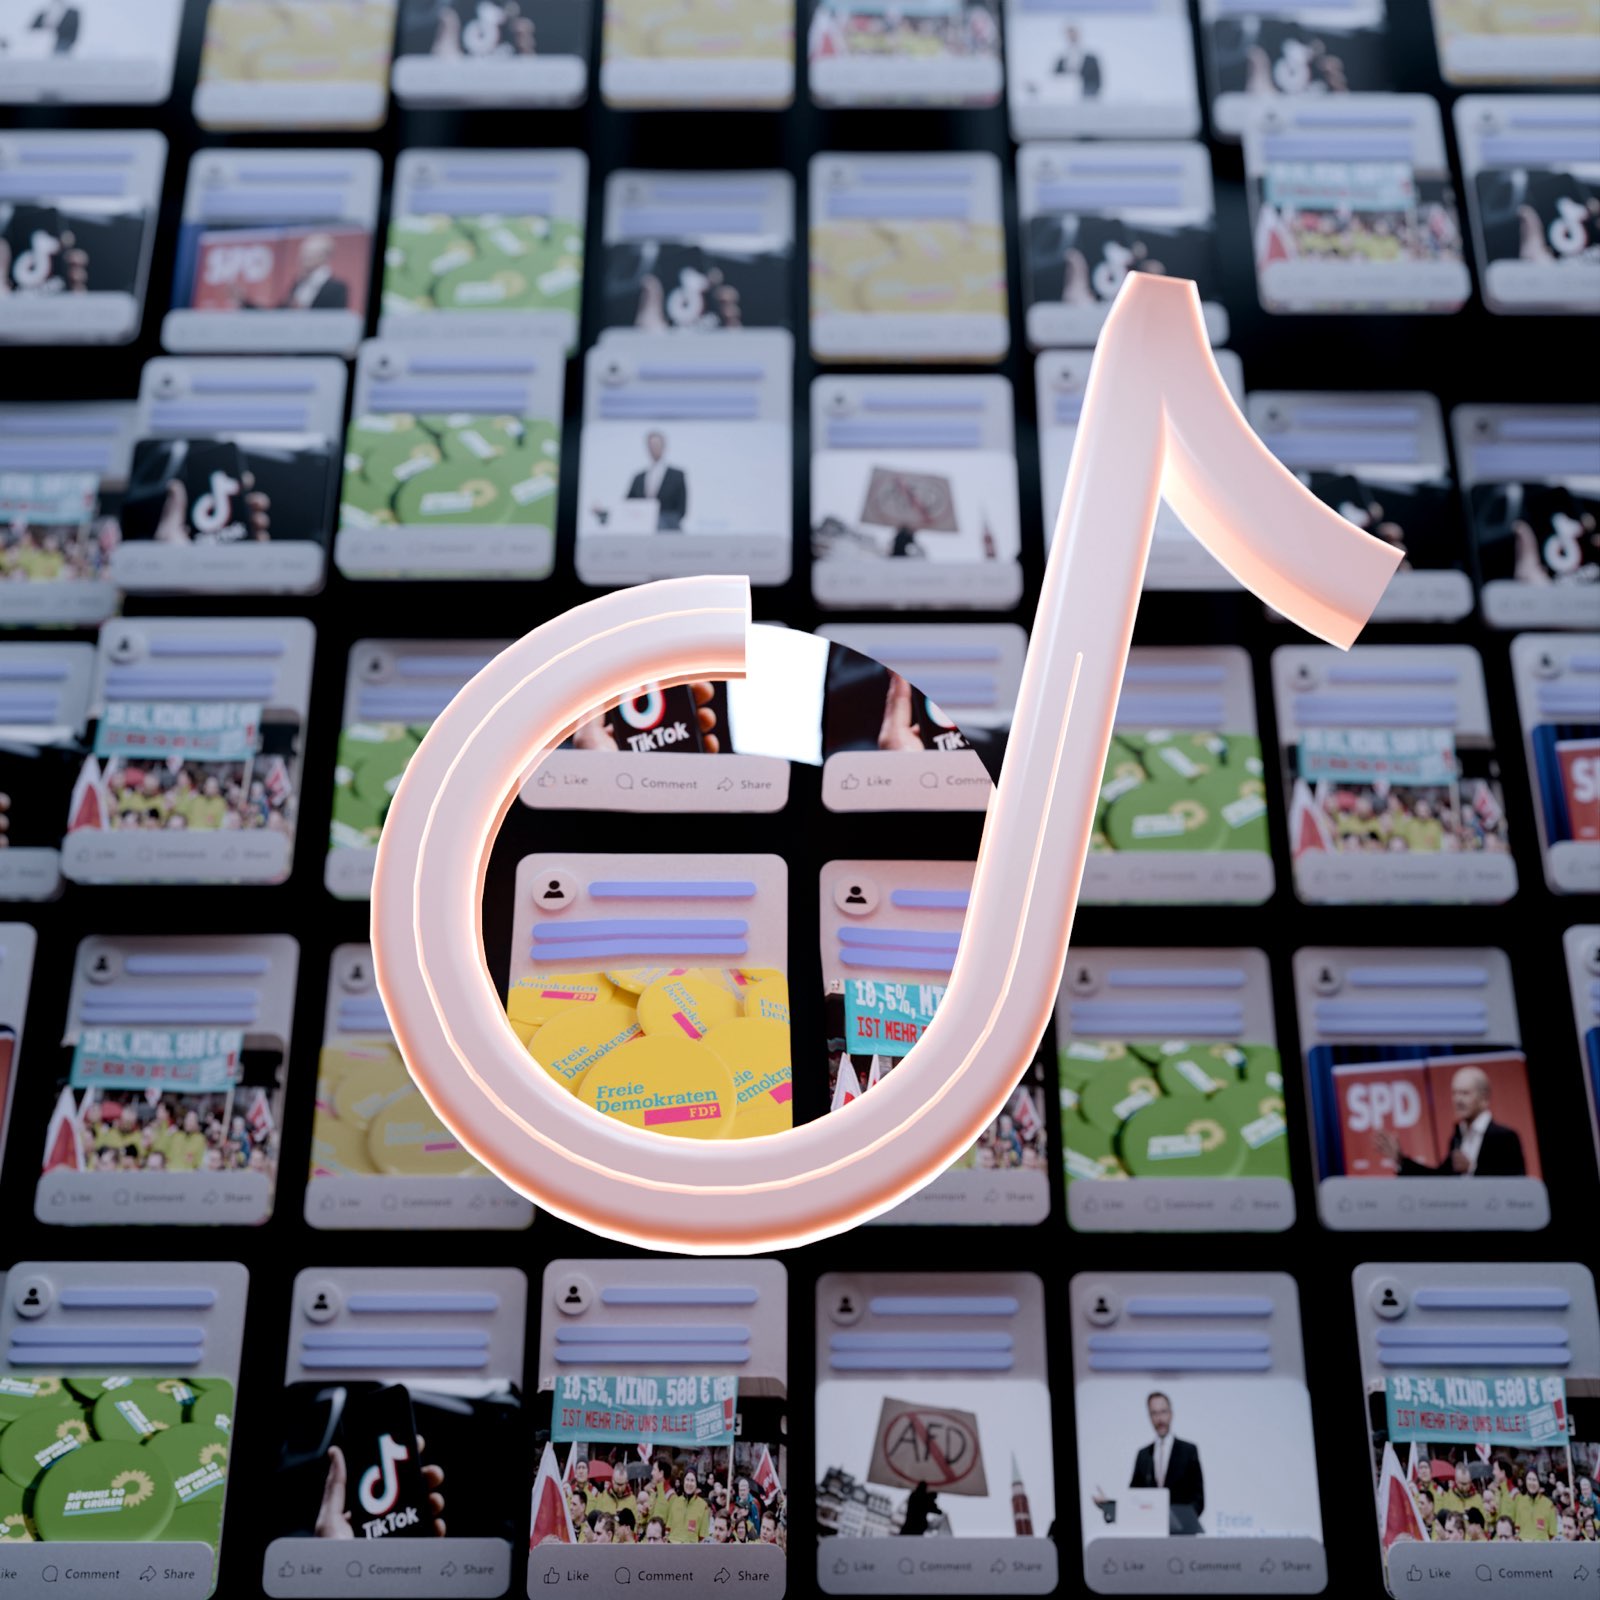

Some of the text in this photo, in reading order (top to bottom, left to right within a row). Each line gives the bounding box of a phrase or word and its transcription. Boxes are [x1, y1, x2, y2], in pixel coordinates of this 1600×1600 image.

[627, 721, 690, 753] TikTok
[933, 731, 970, 752] Tik
[564, 776, 772, 790] Like Comment Share
[867, 777, 892, 787] Like
[857, 1016, 880, 1038] IST
[884, 1020, 918, 1043] MEHR
[551, 1045, 590, 1072] Freie
[596, 1082, 645, 1100] Freie
[596, 1089, 718, 1113] Demokraten
[1346, 1081, 1421, 1131] SPD
[689, 1106, 718, 1118] FDP
[615, 1376, 663, 1407] MIND.
[666, 1376, 697, 1407] 500
[562, 1408, 581, 1428] IST
[585, 1410, 611, 1430] MEHR
[614, 1409, 635, 1431] FÜR
[638, 1414, 658, 1432] UNS
[661, 1413, 693, 1432] ALLE!
[1397, 1408, 1416, 1427] IST
[1420, 1411, 1446, 1430] MEHR
[1449, 1410, 1471, 1432] FÜR
[1472, 1415, 1492, 1432] UNS
[362, 1506, 419, 1540] TikTok
[65, 1568, 120, 1580] Comment
[164, 1568, 195, 1580] Share
[301, 1564, 495, 1576] Like Comment Share
[567, 1570, 770, 1582] Like Comment Share
[919, 1561, 972, 1573] Comment
[1012, 1561, 1042, 1573] Share
[1189, 1561, 1242, 1573] Comment
[1282, 1561, 1312, 1573] Share
[1429, 1568, 1553, 1580] Like Comment
